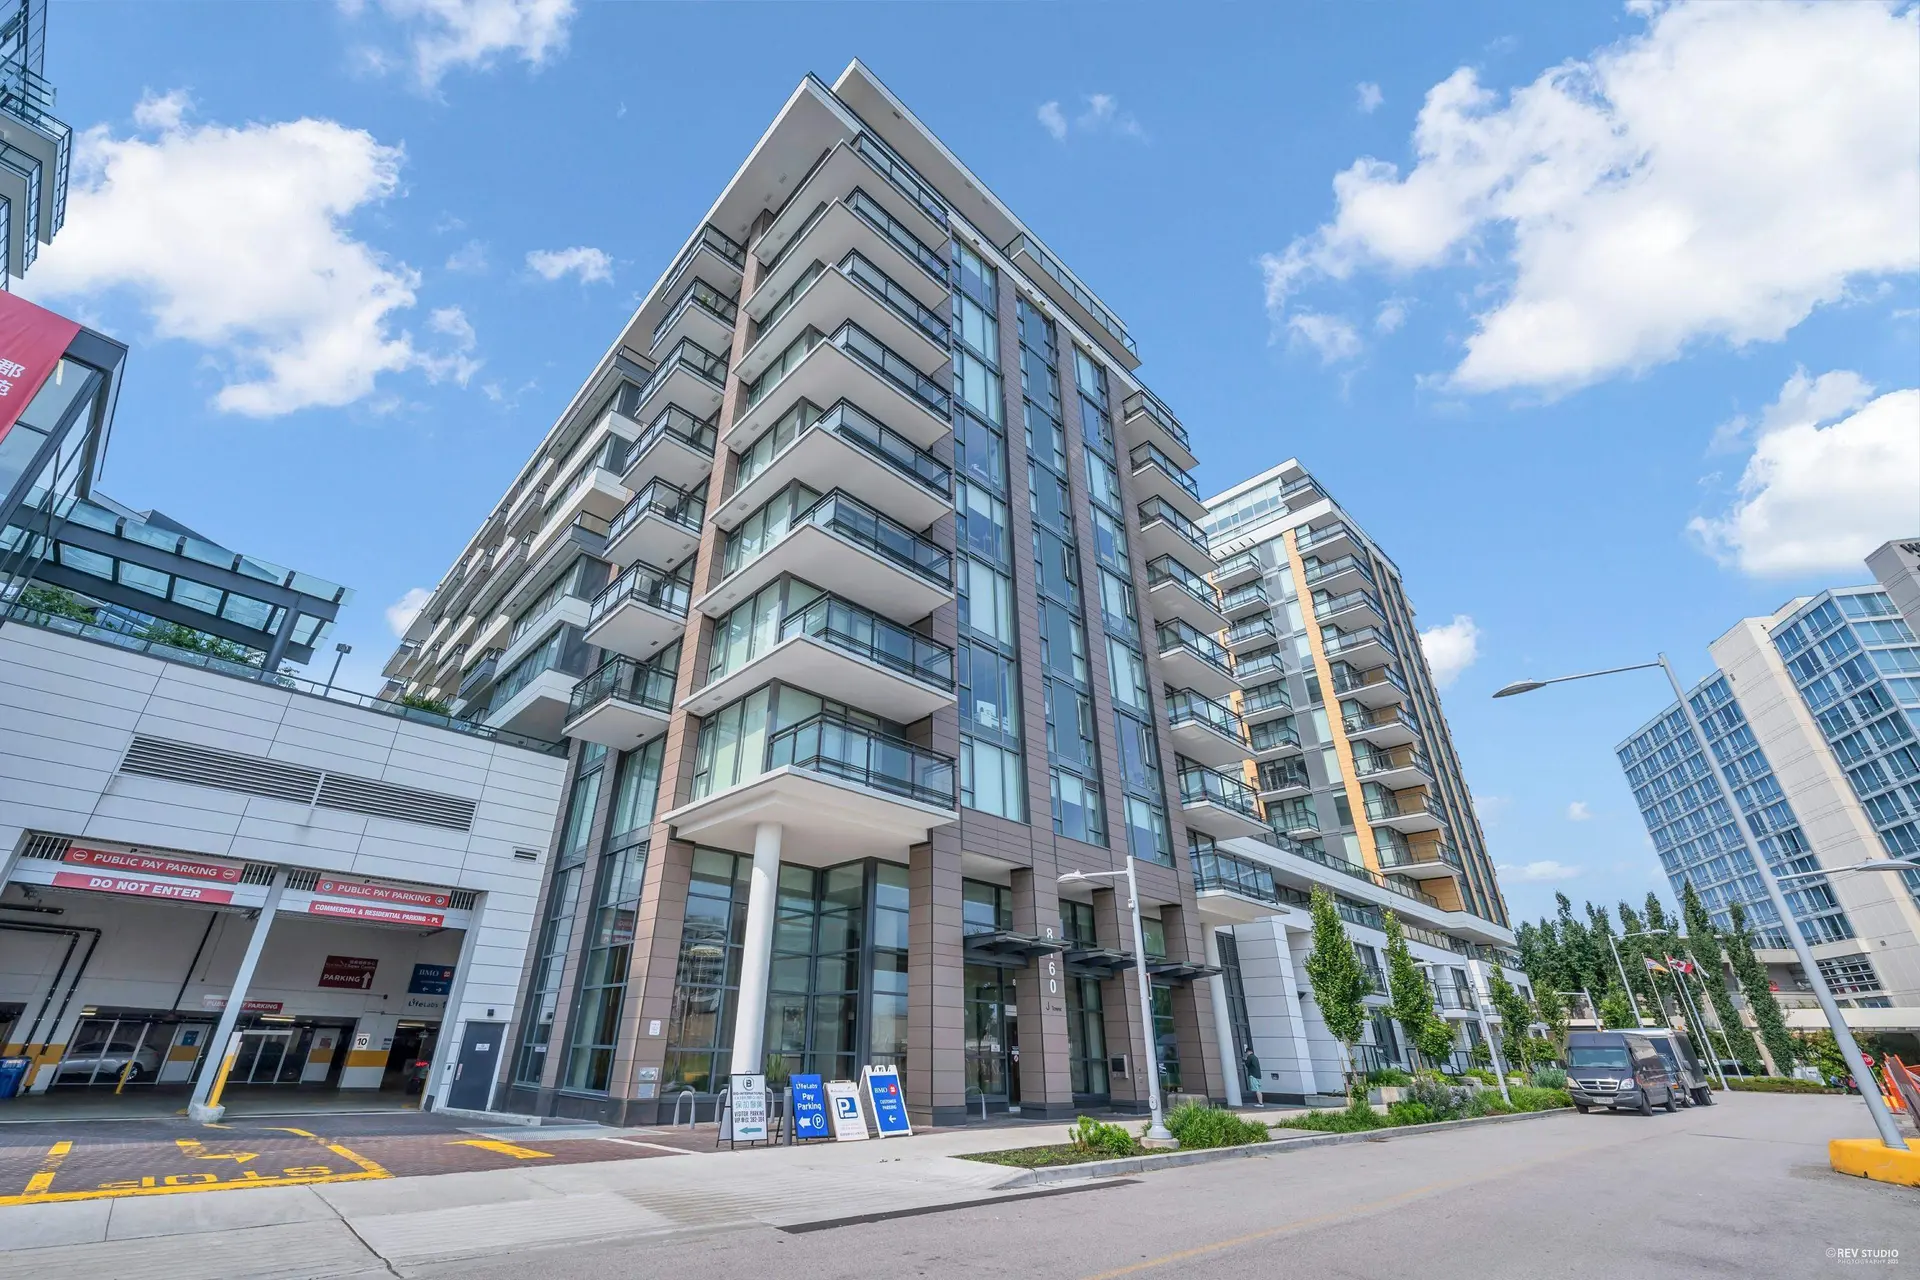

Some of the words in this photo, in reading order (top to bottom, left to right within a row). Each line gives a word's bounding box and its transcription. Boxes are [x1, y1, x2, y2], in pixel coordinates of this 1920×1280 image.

[93, 853, 138, 867] PUBLIC
[141, 859, 164, 869] PAY
[166, 862, 218, 877] PARKING
[89, 878, 113, 889] DO
[116, 881, 150, 893] NOT
[152, 885, 201, 899] ENTER
[337, 884, 371, 895] PUBLIC
[373, 889, 390, 898] PAY
[392, 892, 431, 903] PARKING
[315, 904, 356, 915] COMMERCIAL
[364, 909, 401, 919] RESIDENTIAL
[402, 914, 426, 922] PARKING
[419, 968, 440, 977] BMO
[323, 973, 361, 983] PARKING
[206, 1000, 227, 1008] PUBL
[408, 998, 439, 1008] LifeLabs
[1046, 1001, 1050, 1011] J
[357, 1037, 368, 1046] 10
[796, 1081, 818, 1090] LifeLabs
[802, 1092, 815, 1102] Pay
[797, 1102, 822, 1111] Parking
[734, 1110, 749, 1118] VISITOR
